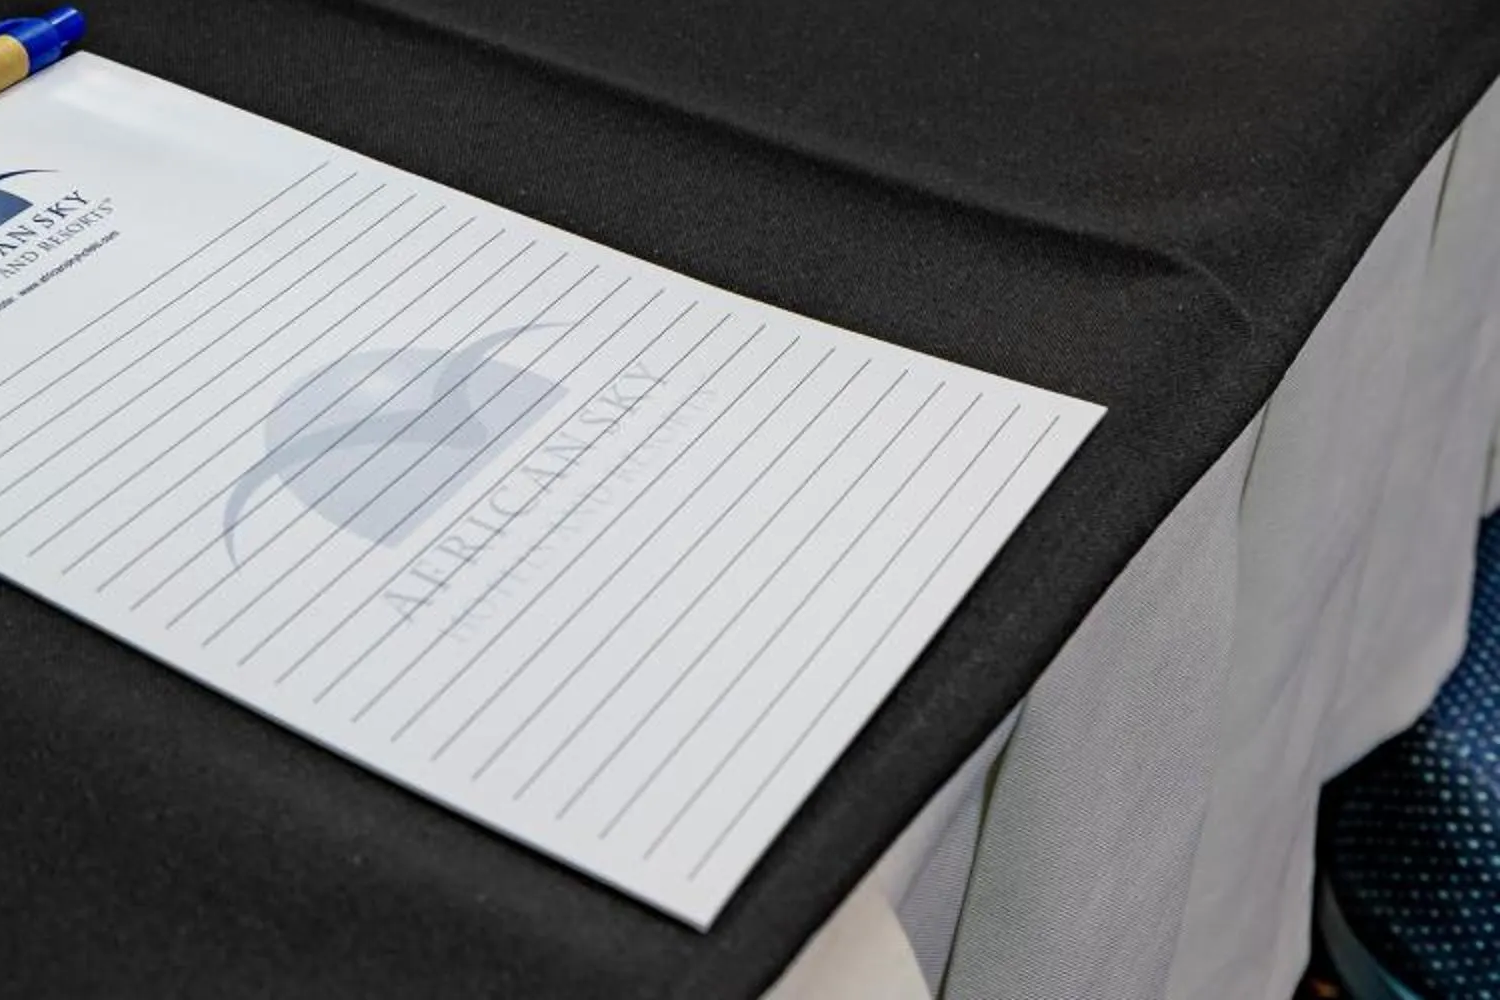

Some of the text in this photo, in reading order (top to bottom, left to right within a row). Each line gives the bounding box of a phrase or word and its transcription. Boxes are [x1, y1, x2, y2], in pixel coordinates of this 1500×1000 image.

[33, 189, 90, 228] SKY
[1, 249, 41, 279] AND
[383, 360, 668, 625] AFRICAN SKY
